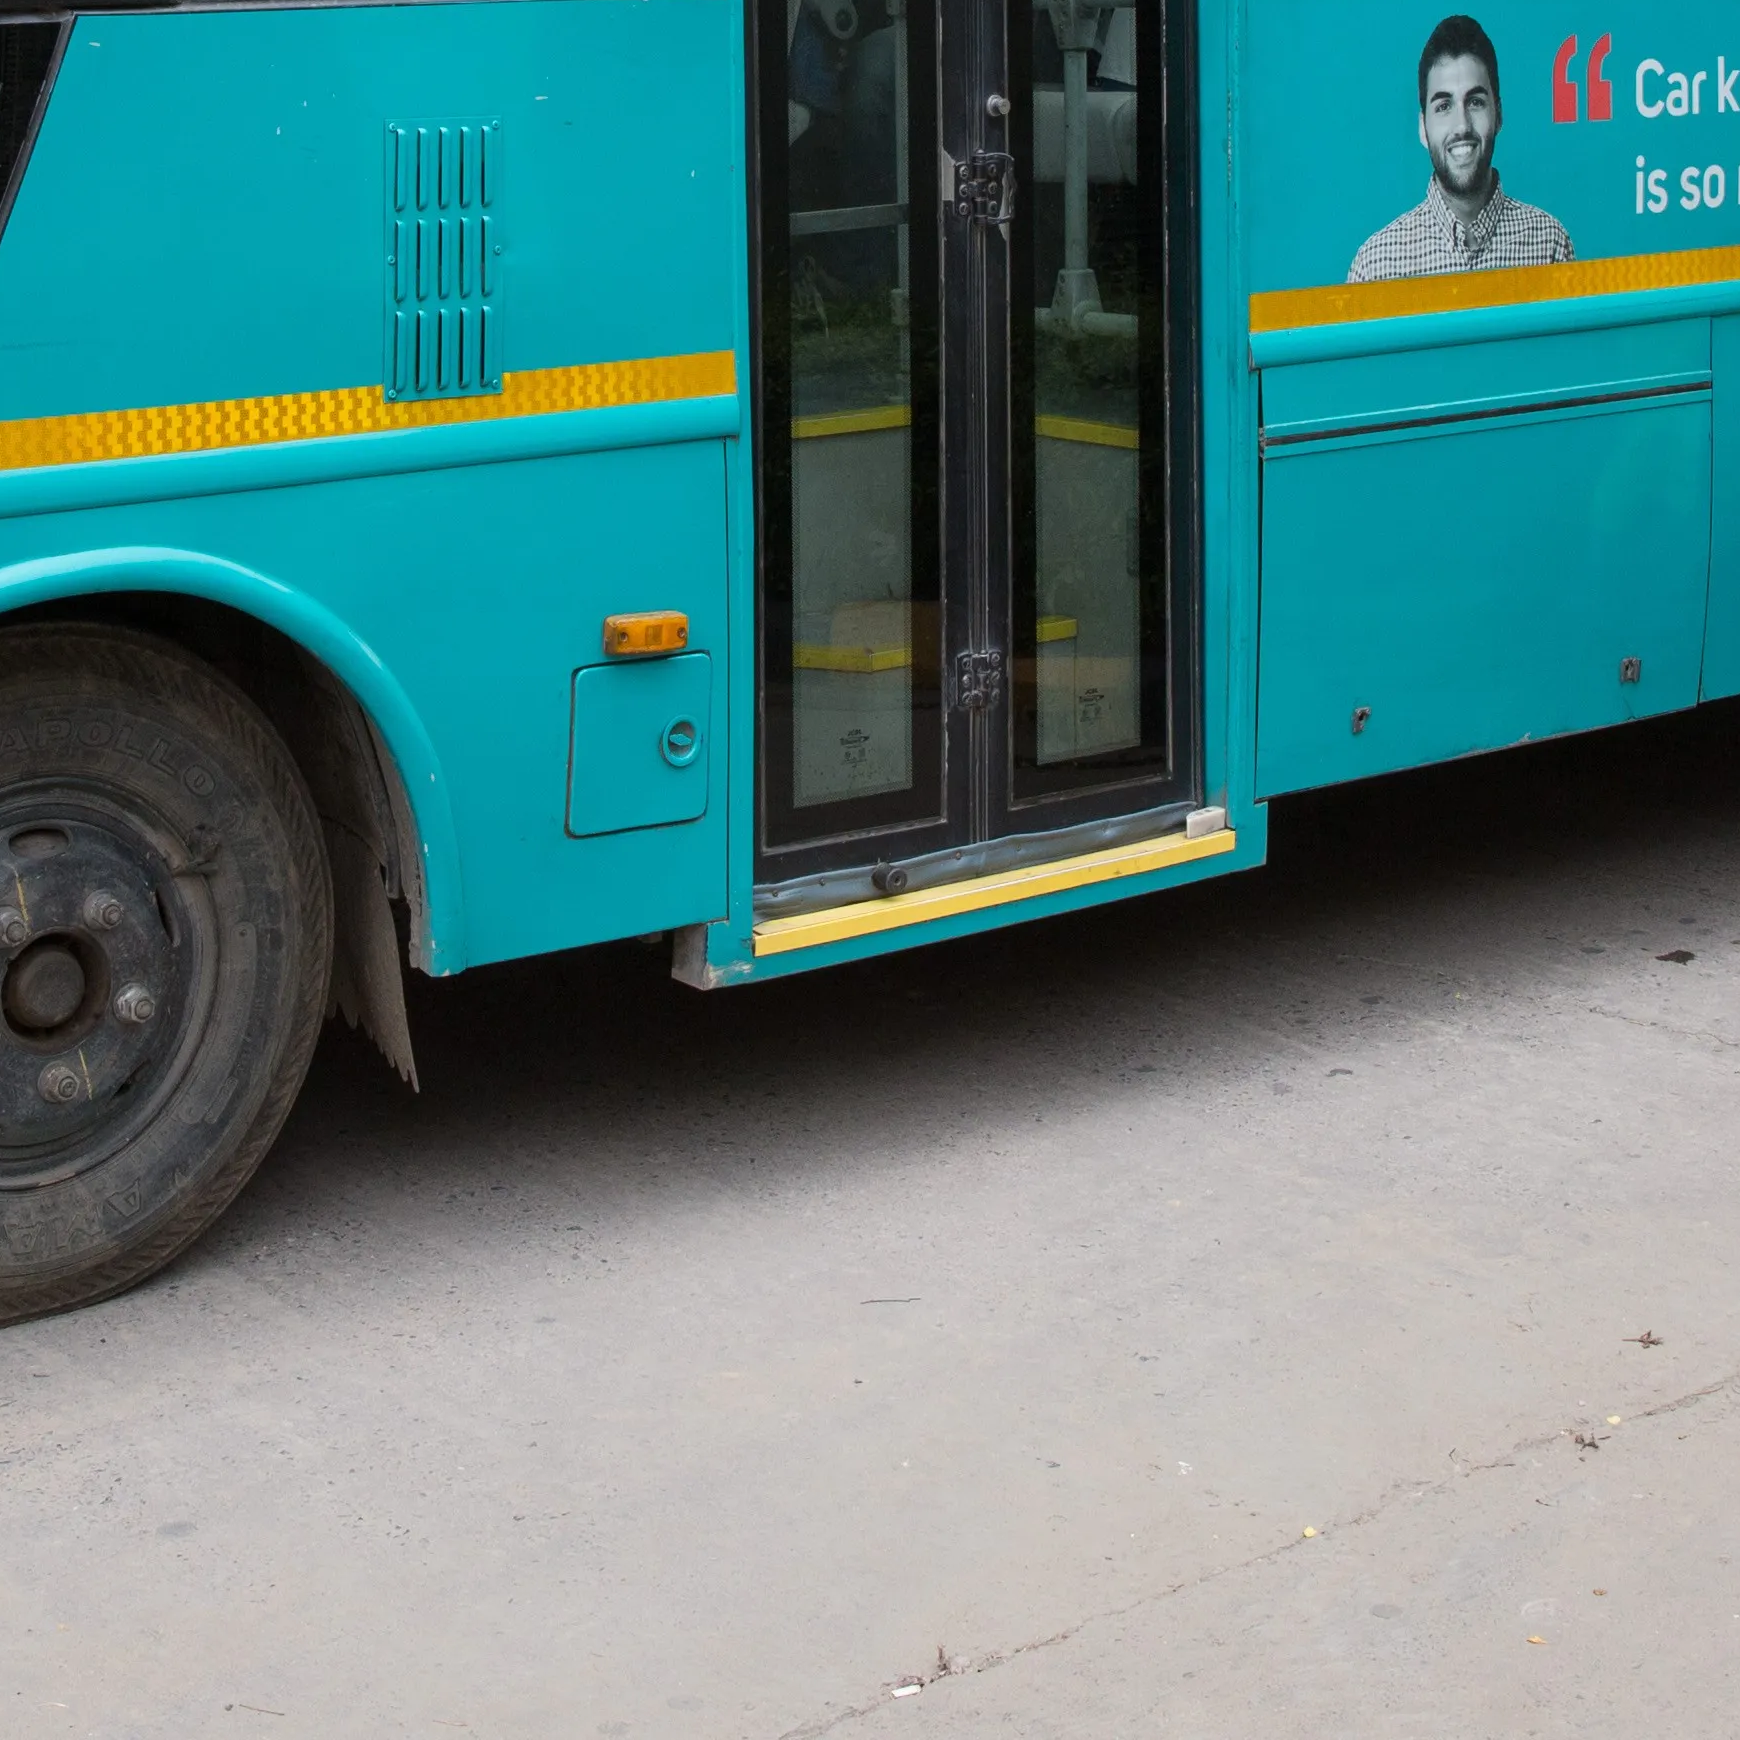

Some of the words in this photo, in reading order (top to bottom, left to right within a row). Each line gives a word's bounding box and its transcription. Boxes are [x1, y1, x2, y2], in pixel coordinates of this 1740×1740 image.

[1635, 58, 1708, 118] Car
[1635, 155, 1669, 215] is
[1680, 164, 1726, 211] so
